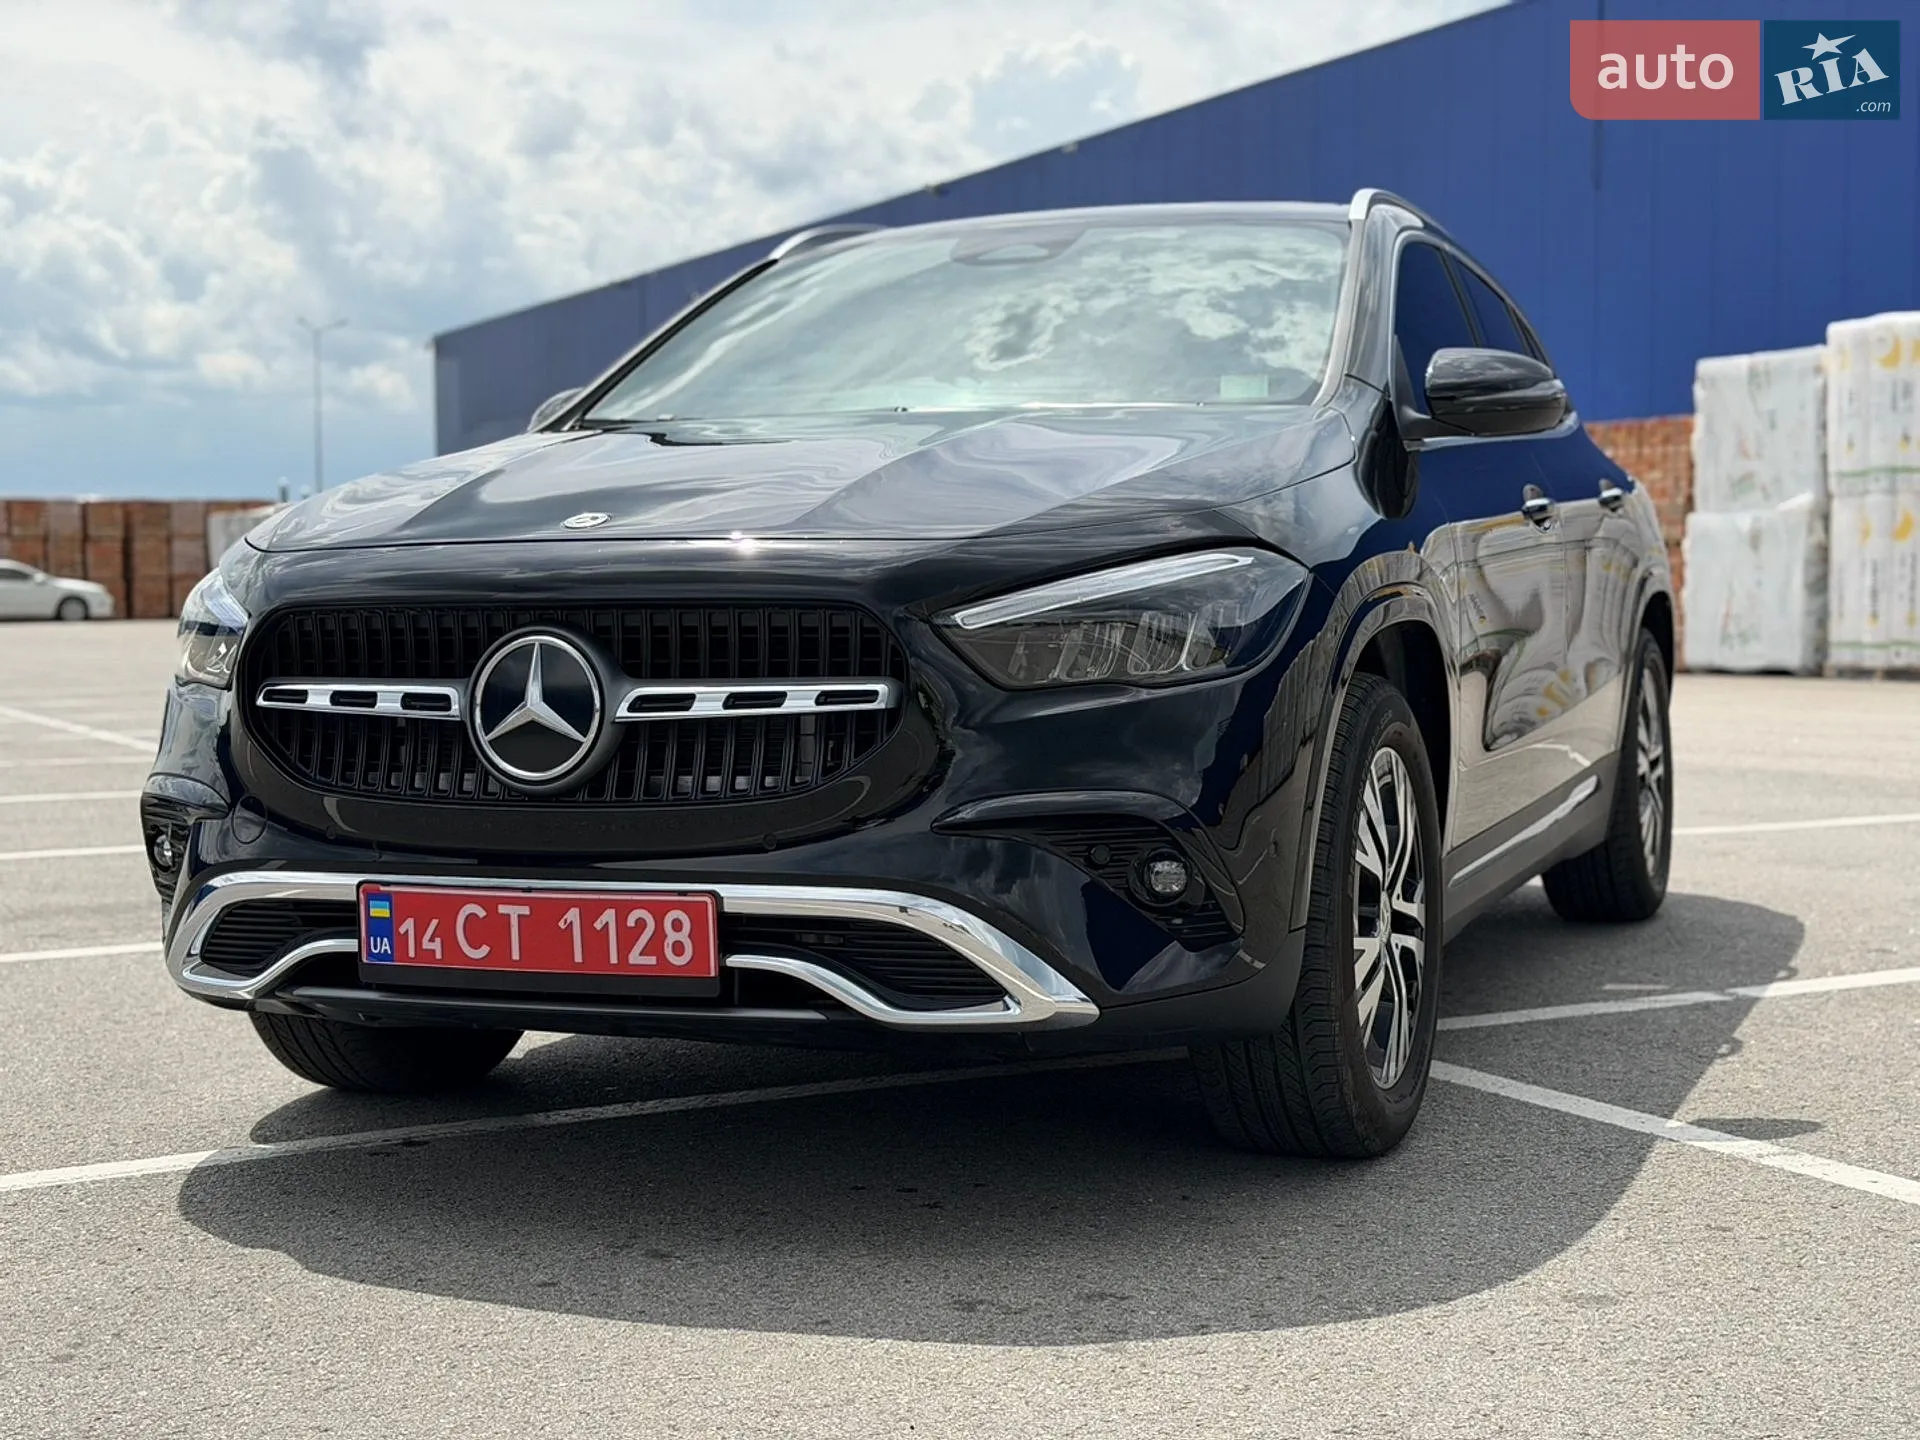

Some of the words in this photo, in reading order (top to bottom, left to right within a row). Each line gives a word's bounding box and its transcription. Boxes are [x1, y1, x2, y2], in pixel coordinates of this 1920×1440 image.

[370, 937, 391, 954] UA
[399, 917, 442, 960] 14
[455, 903, 530, 961] CT
[558, 907, 693, 966] 1128
